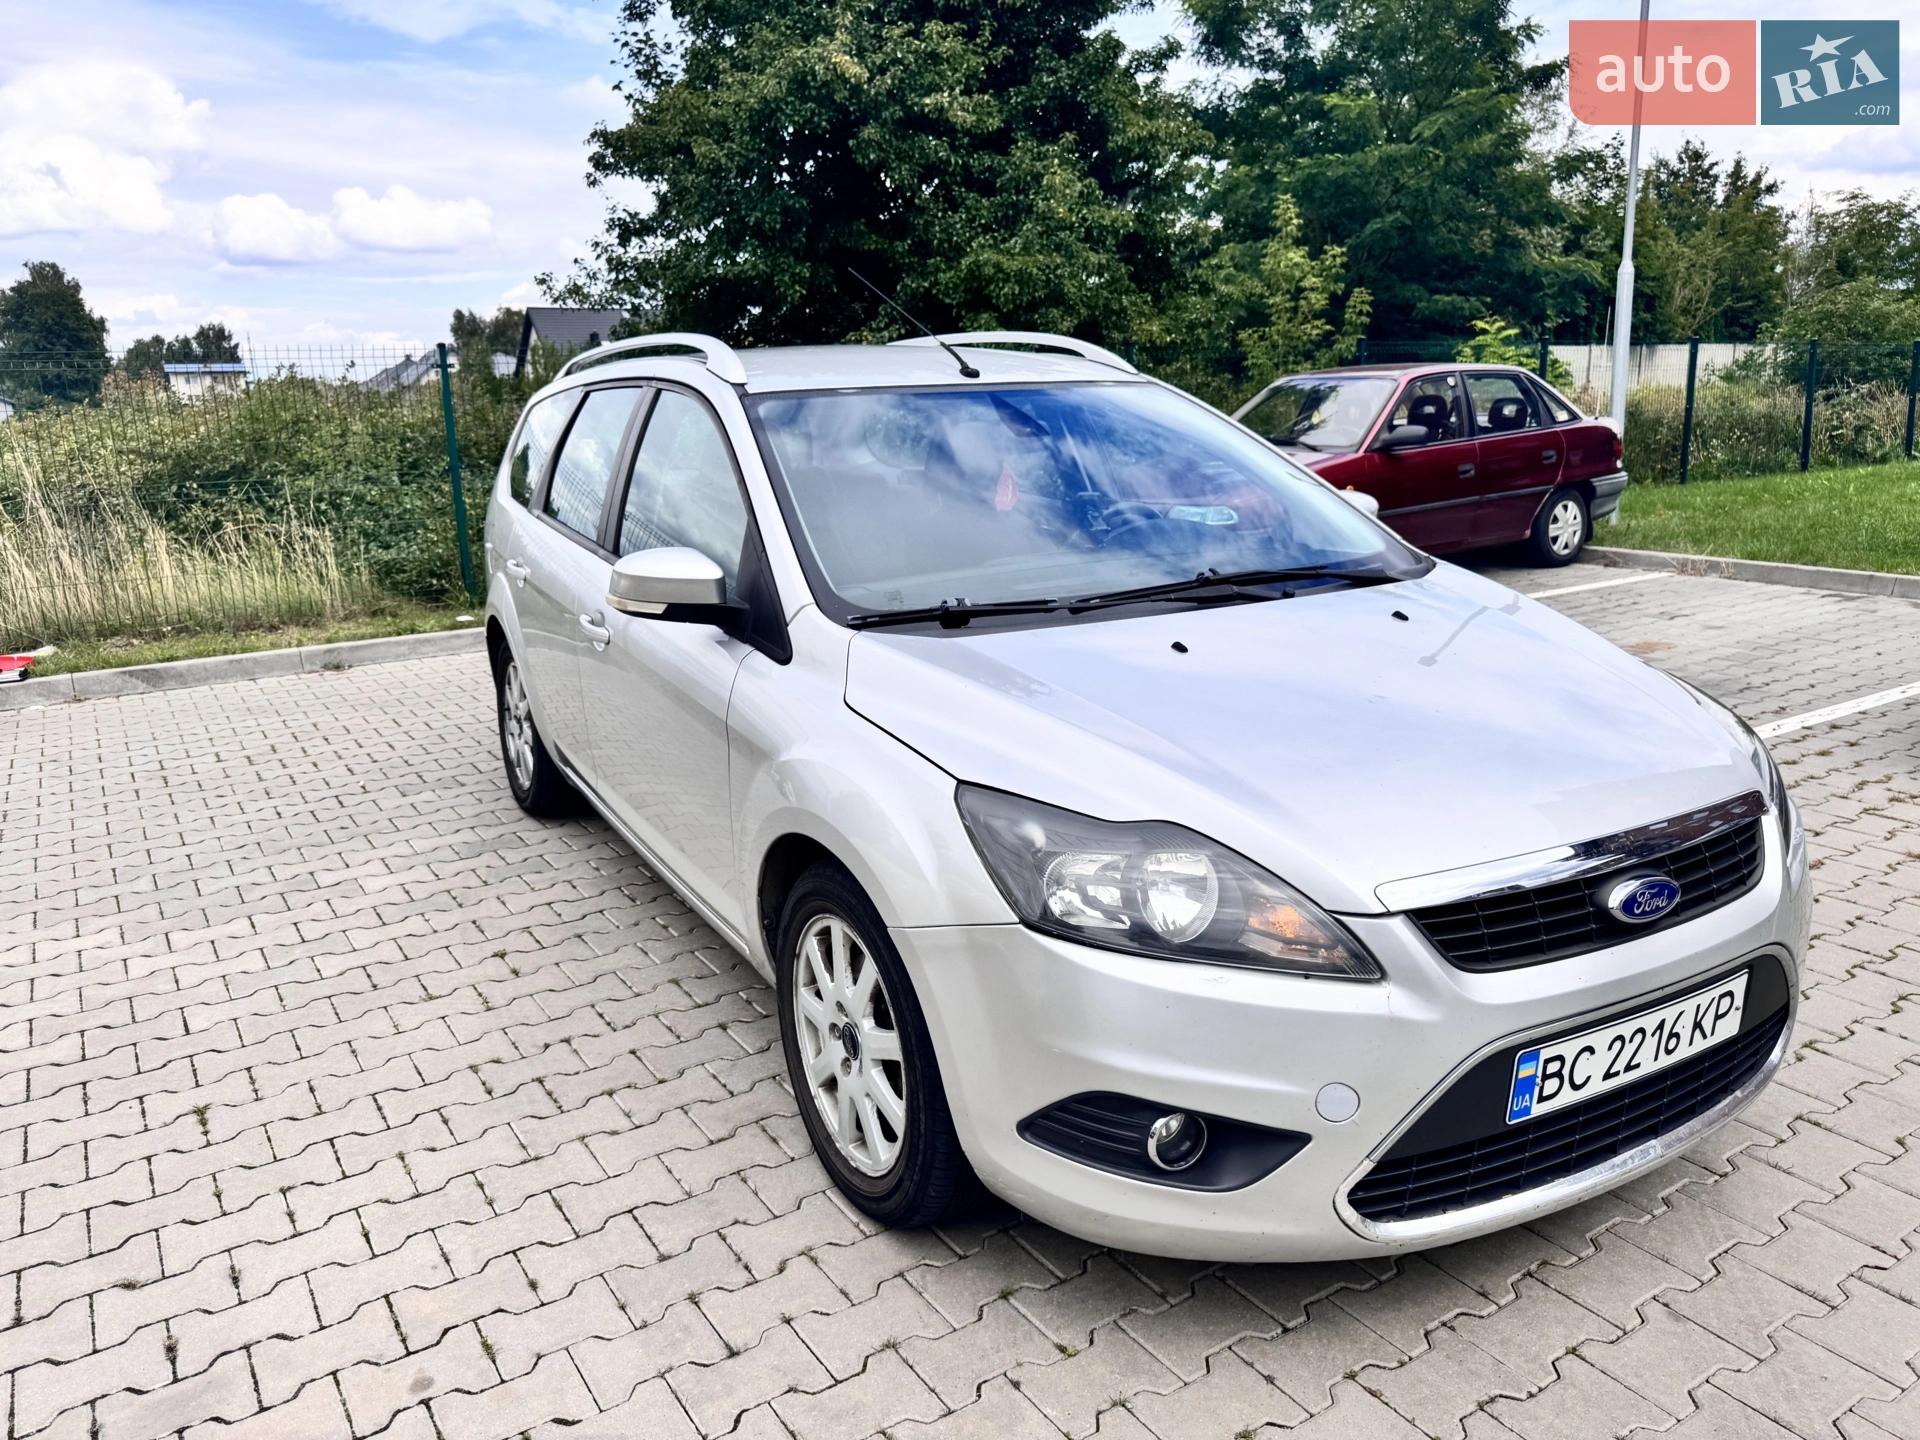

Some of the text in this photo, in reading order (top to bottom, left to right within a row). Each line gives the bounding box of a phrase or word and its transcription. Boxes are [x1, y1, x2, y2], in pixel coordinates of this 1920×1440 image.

[1634, 887, 1669, 914] Ford
[1536, 989, 1735, 1105] BC 2216 KP
[1512, 1093, 1531, 1111] UA
